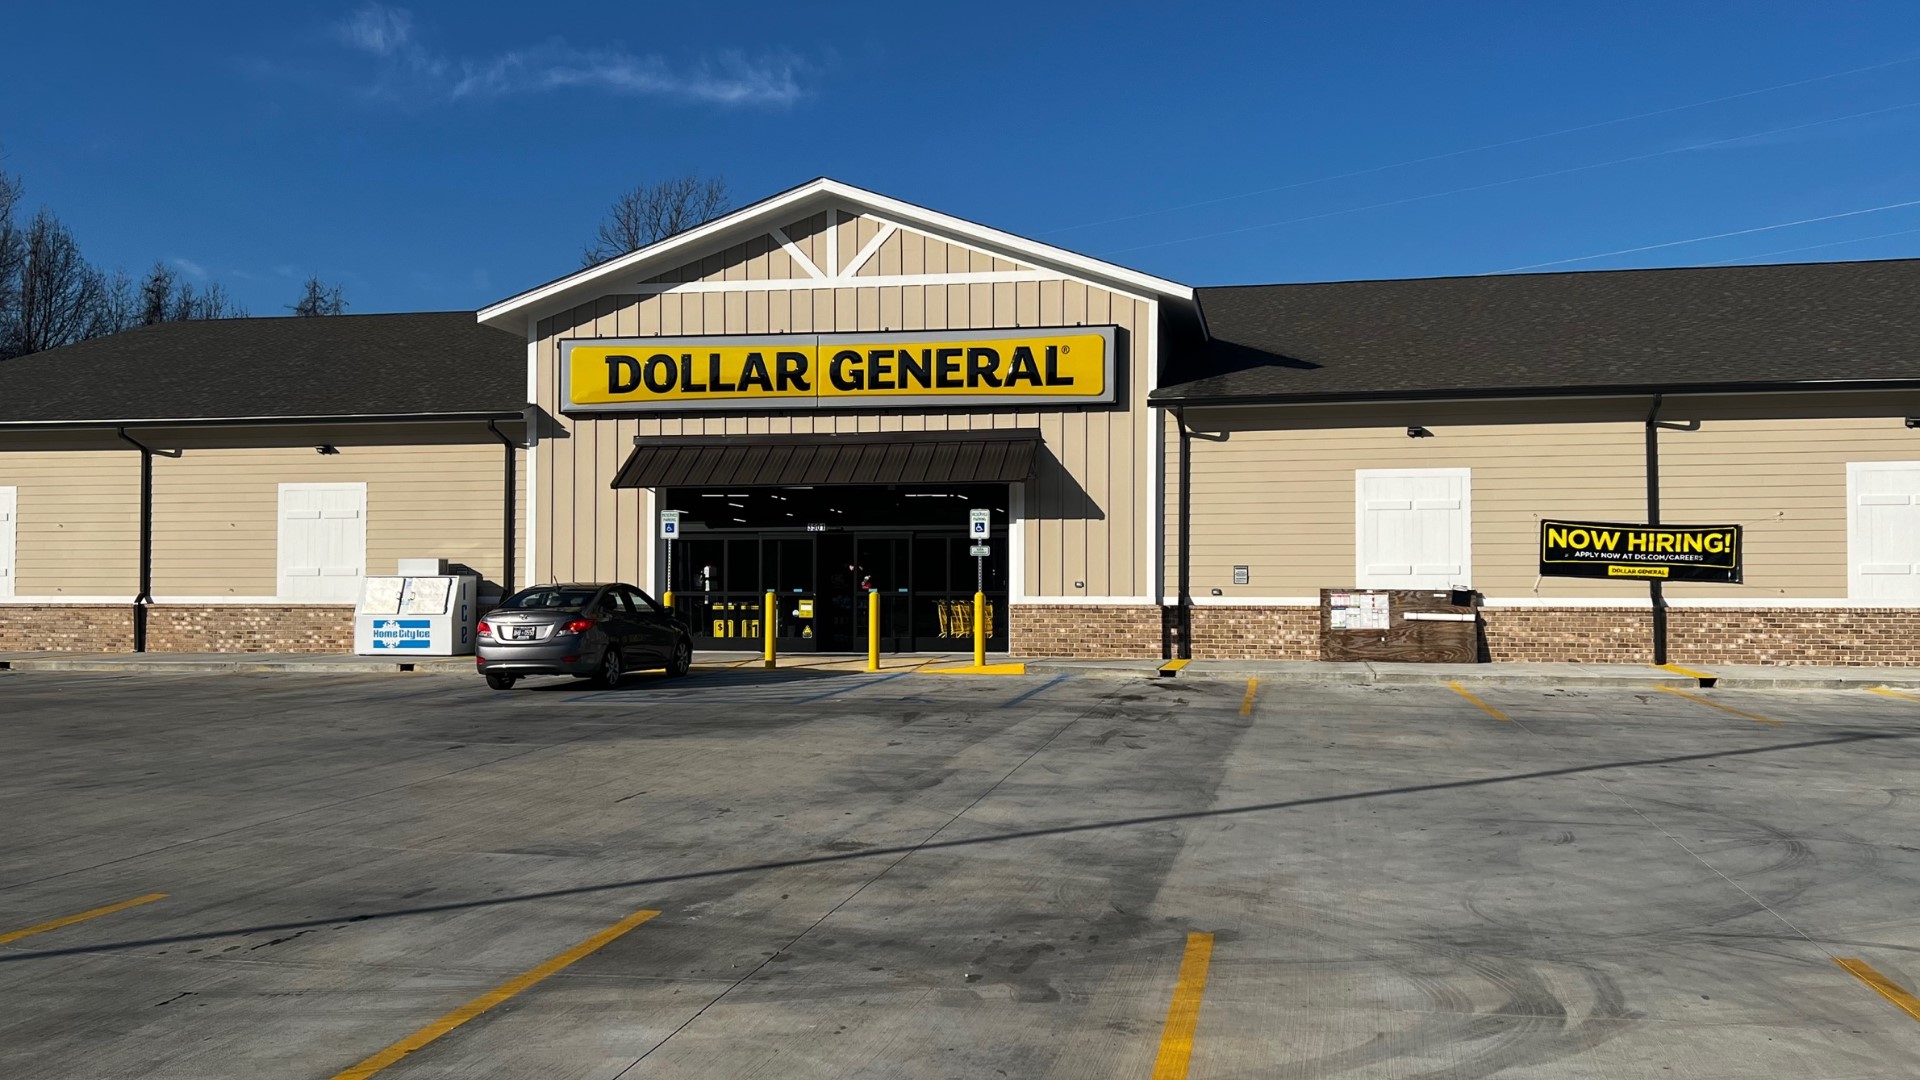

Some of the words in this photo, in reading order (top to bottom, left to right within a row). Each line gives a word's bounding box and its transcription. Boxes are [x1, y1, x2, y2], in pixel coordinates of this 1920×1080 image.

[605, 352, 811, 394] DOLLAR
[1548, 528, 1621, 551] NOW
[1628, 532, 1731, 553] HIRING!
[373, 629, 398, 638] Home
[399, 629, 416, 639] City
[416, 629, 431, 638] Ice
